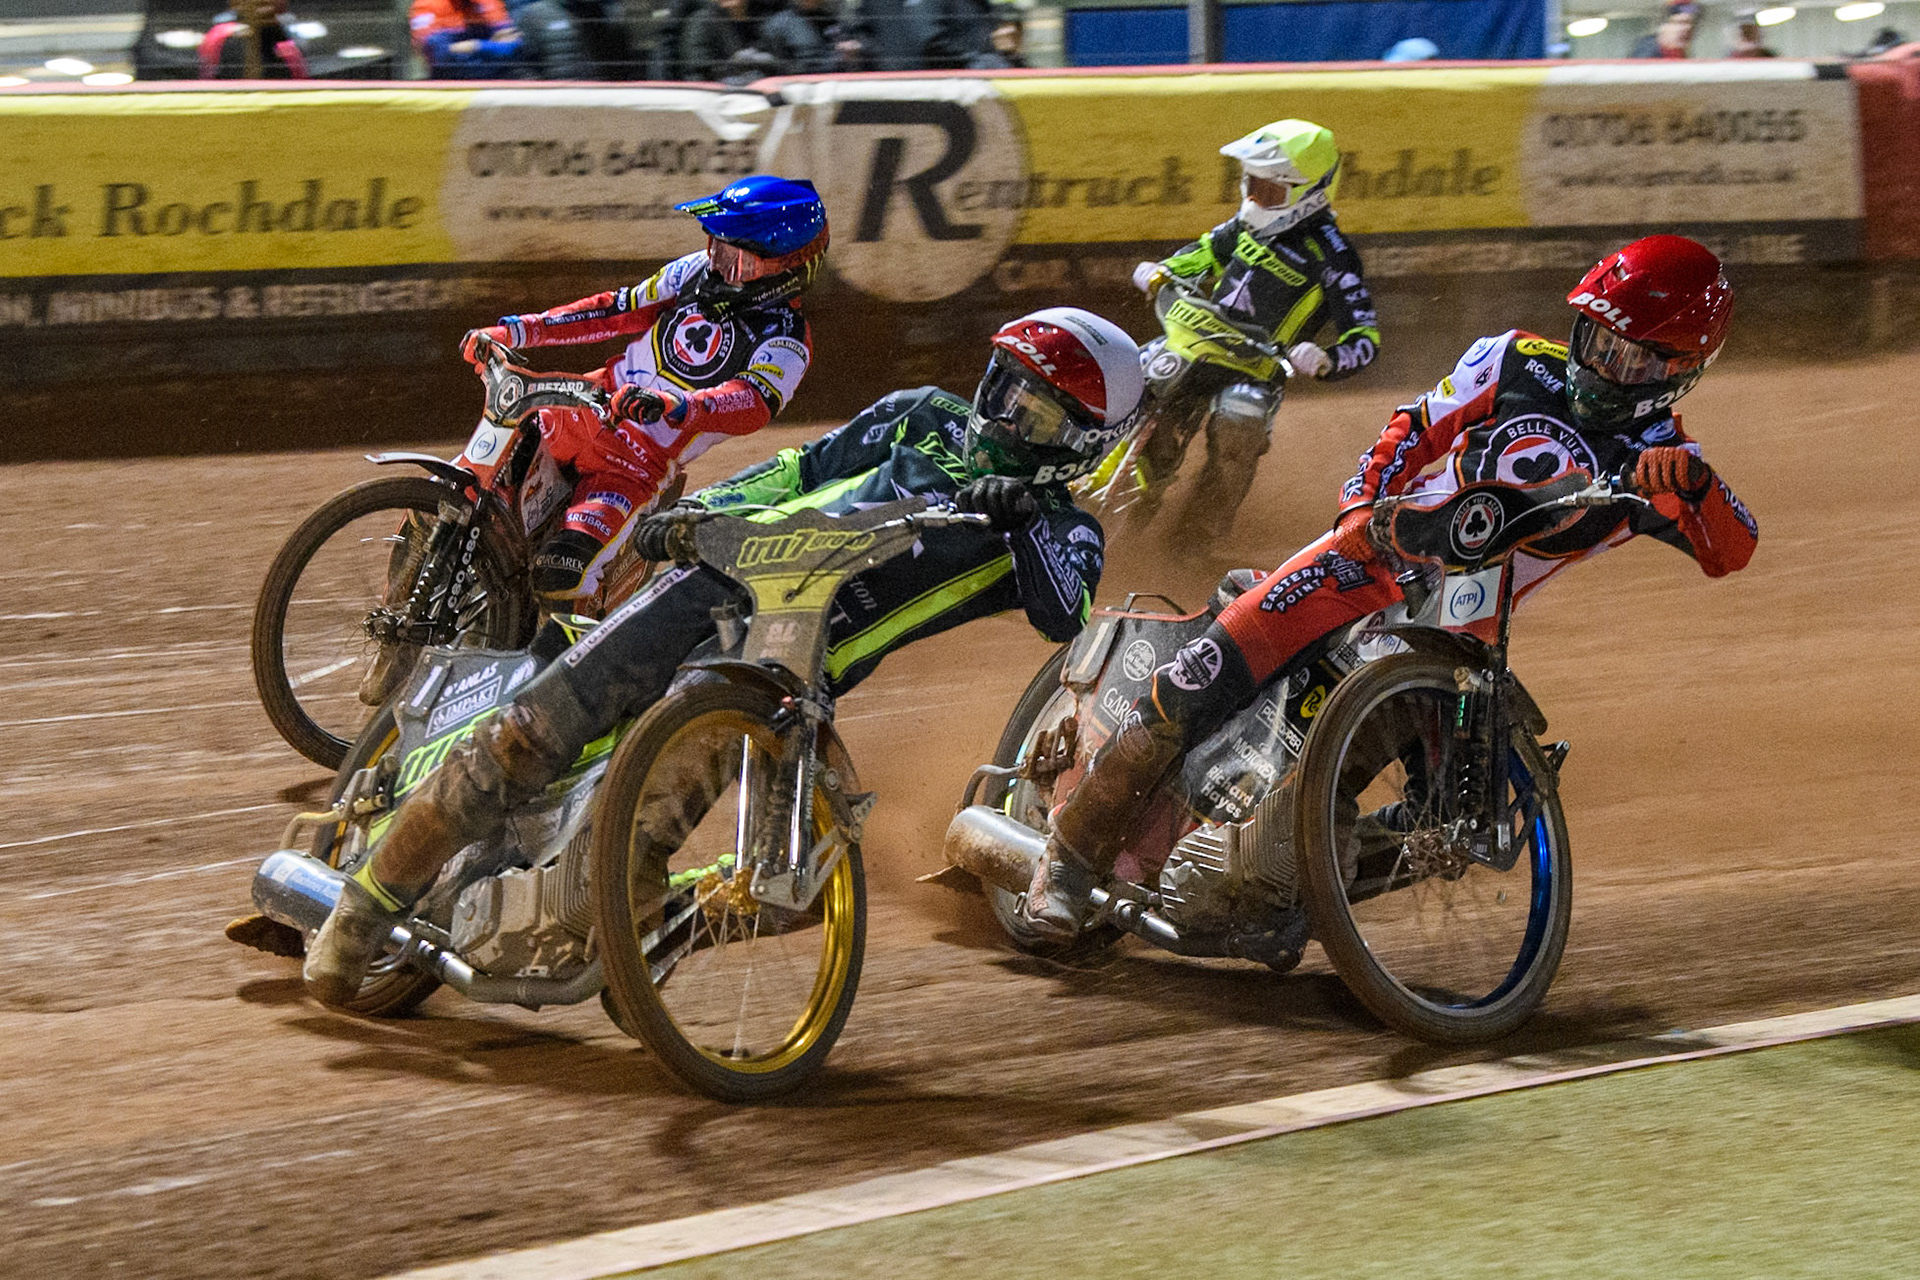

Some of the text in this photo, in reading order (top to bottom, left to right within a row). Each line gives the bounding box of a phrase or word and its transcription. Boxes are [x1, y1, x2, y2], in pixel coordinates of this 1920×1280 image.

[98, 177, 426, 237] Rochdale
[1569, 292, 1633, 332] BOLL
[996, 335, 1058, 377] BOLL
[1524, 358, 1565, 391] ROWE
[1506, 421, 1584, 457] BELLE VUE
[1261, 566, 1325, 611] EASTERN
[1276, 579, 1322, 612] POINT
[1454, 592, 1478, 608] ATPI
[1232, 736, 1277, 783] MOTOREX
[1201, 781, 1242, 818] Hayes
[1206, 764, 1255, 808] Richard
